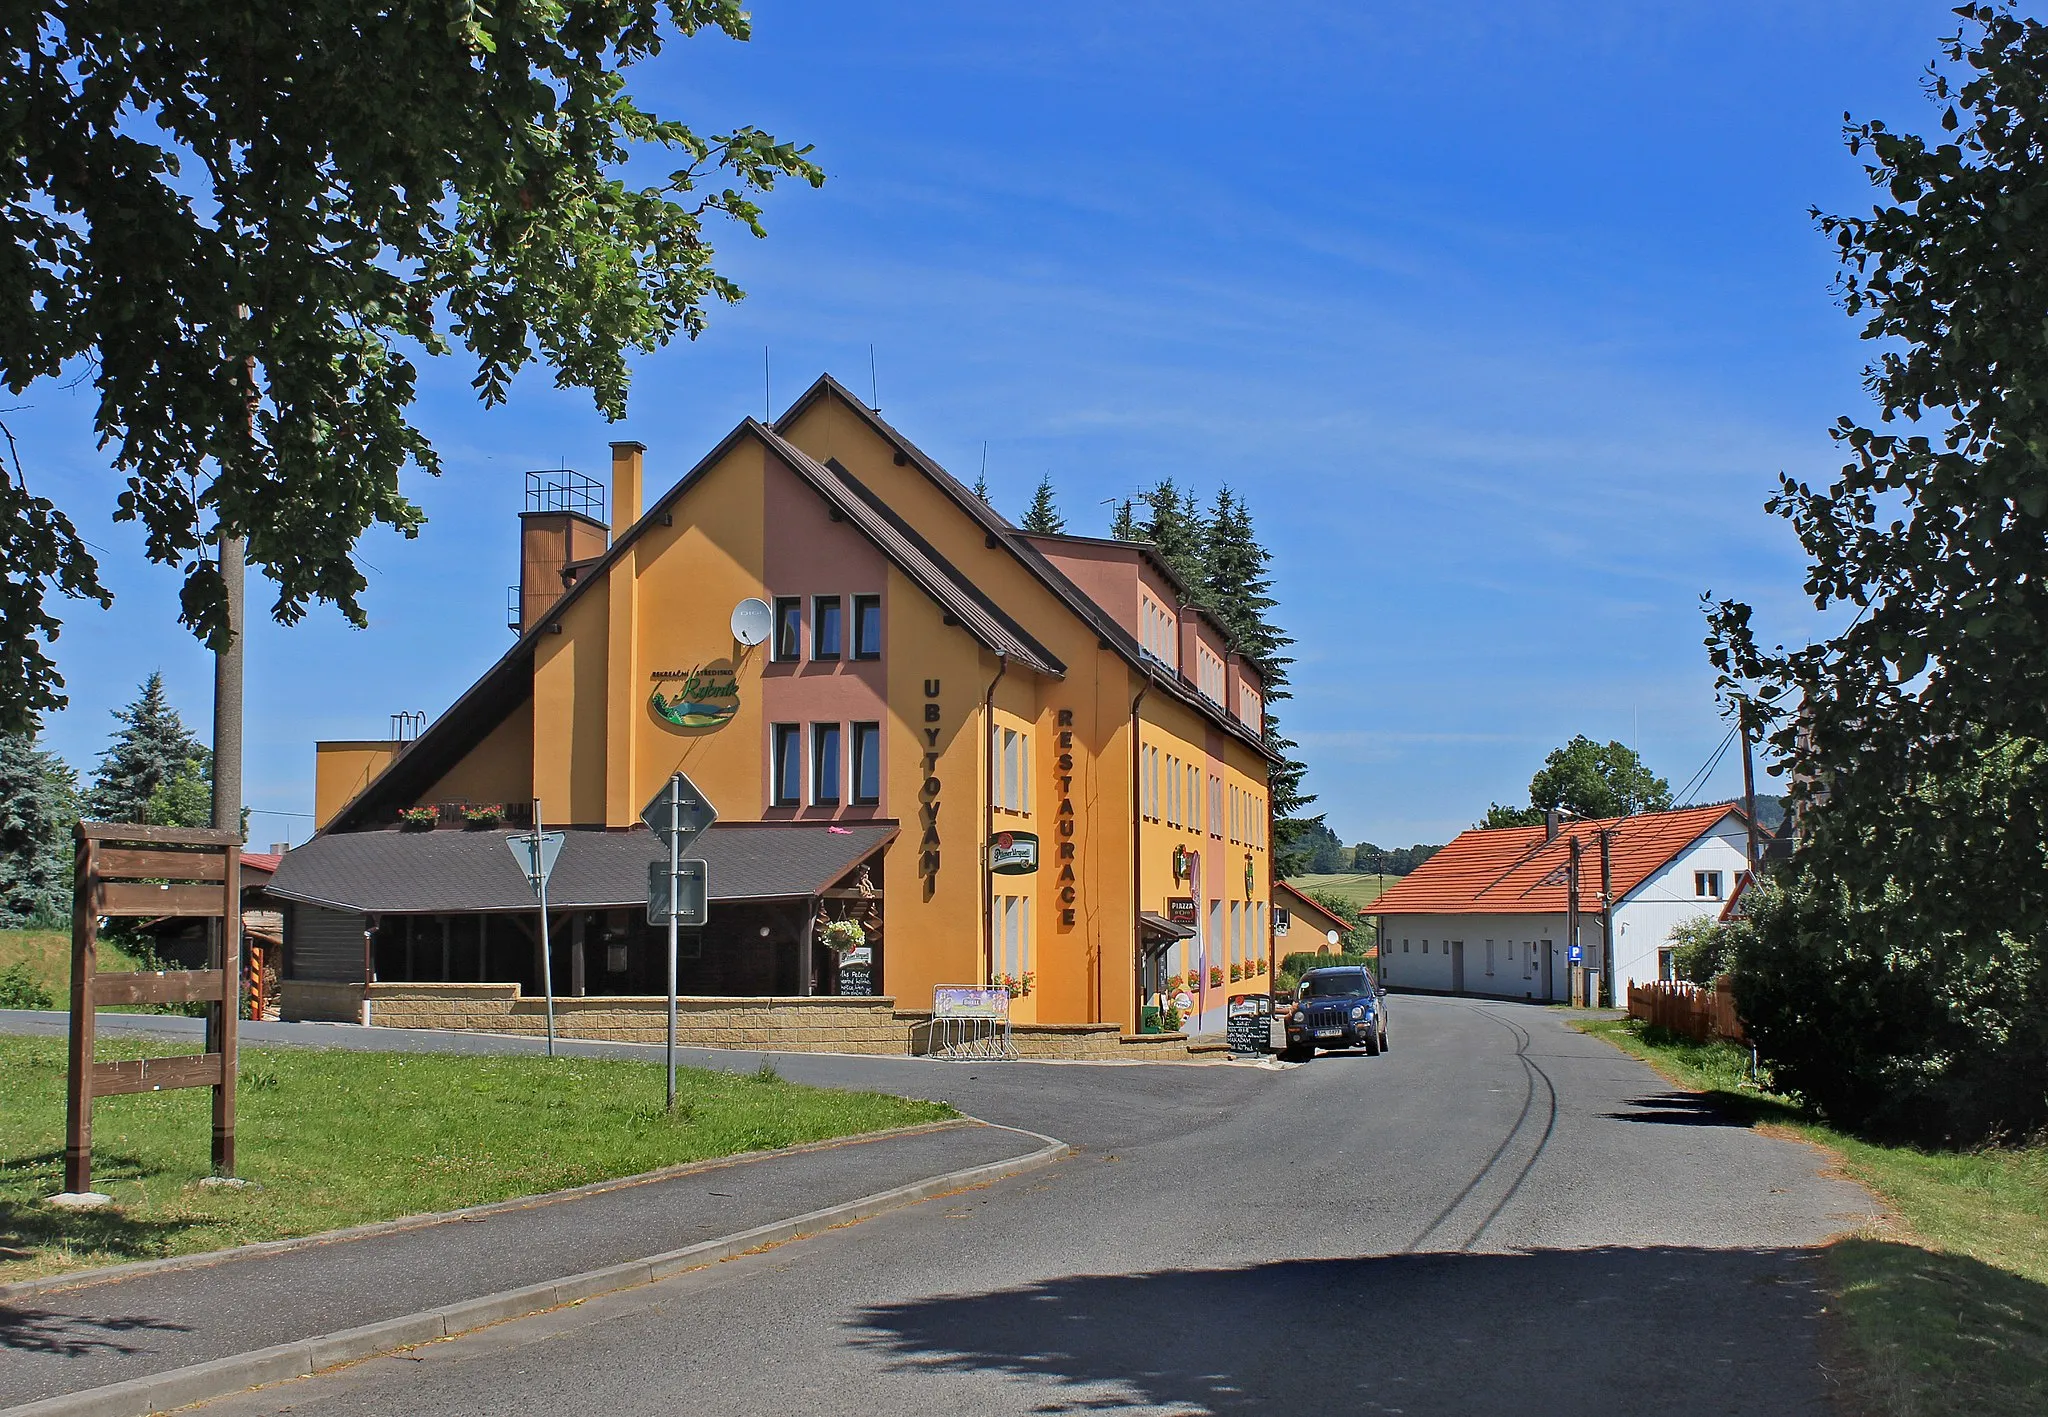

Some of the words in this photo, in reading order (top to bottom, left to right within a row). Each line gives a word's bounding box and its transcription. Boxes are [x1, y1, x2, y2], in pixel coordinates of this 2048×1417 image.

[1058, 710, 1076, 926] RESTAURACE
[1171, 902, 1194, 910] PIAZZA
[1572, 947, 1580, 957] P
